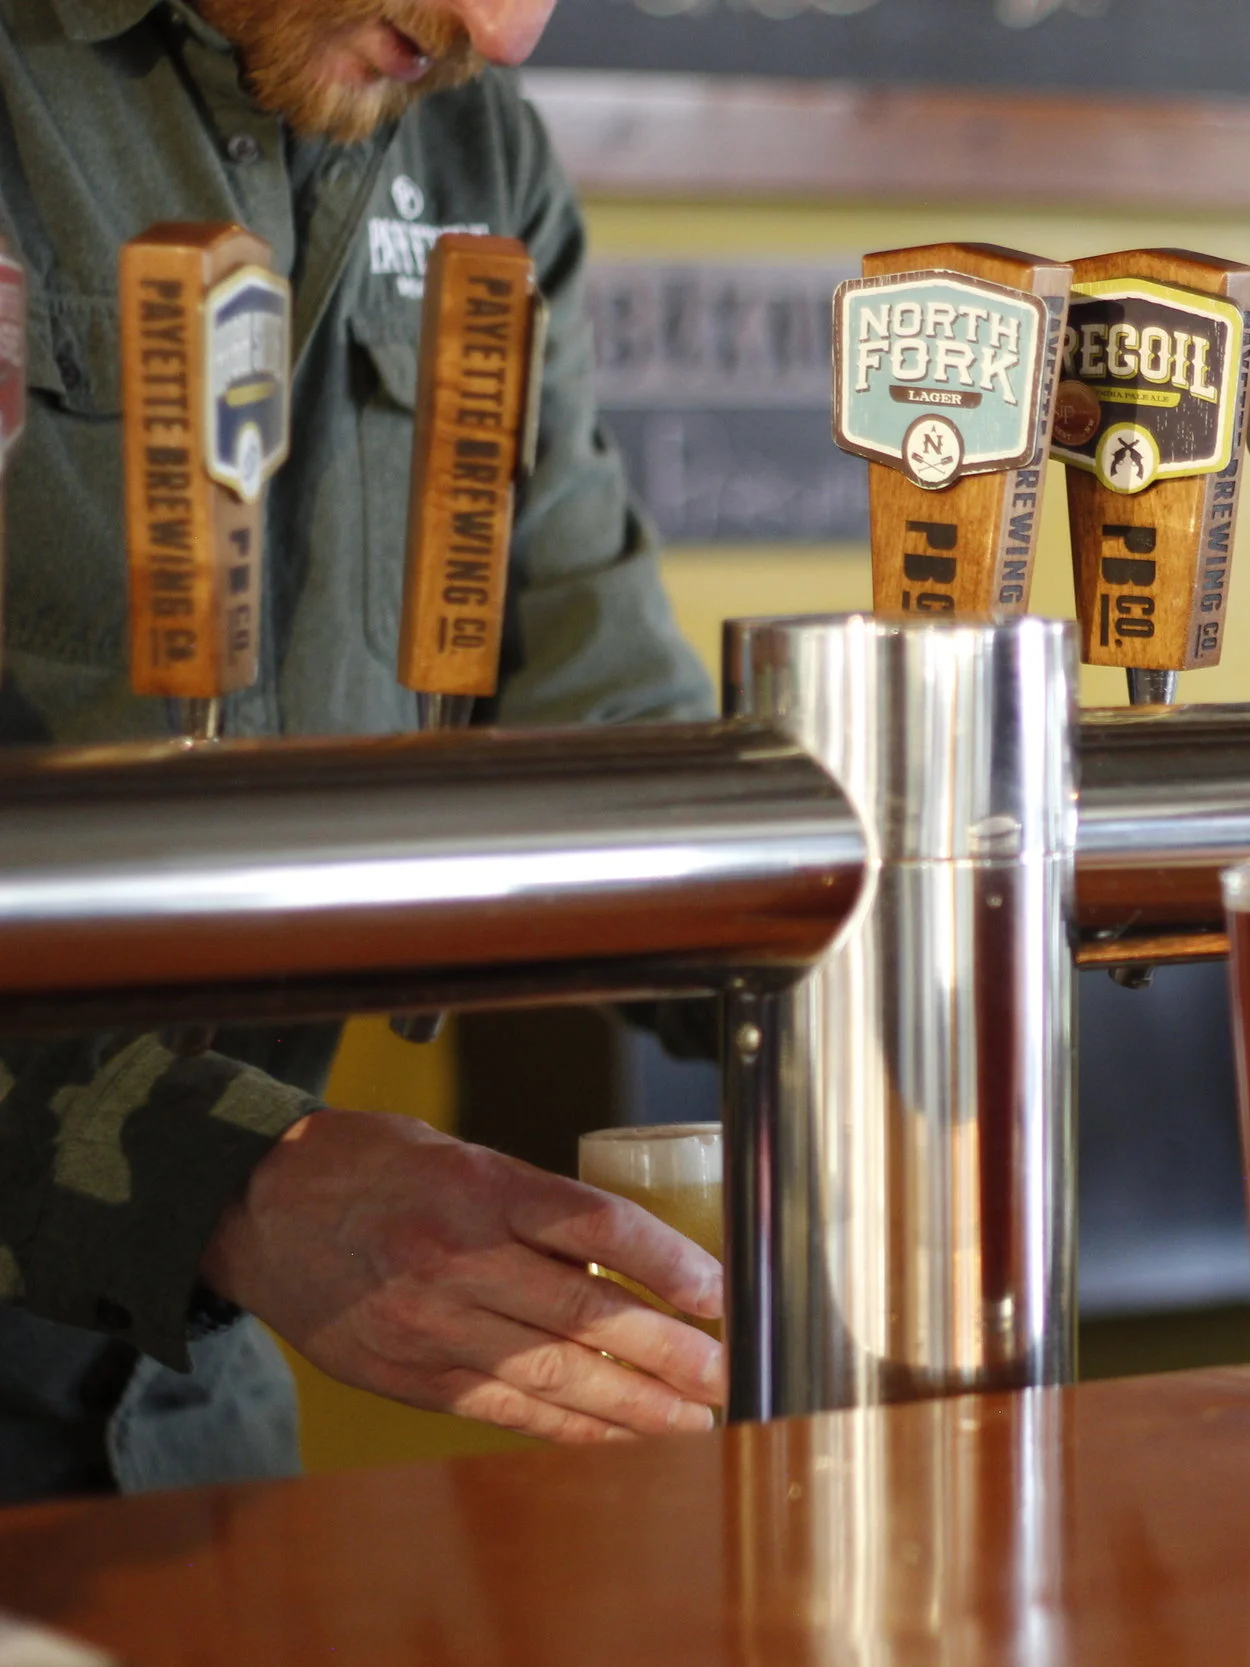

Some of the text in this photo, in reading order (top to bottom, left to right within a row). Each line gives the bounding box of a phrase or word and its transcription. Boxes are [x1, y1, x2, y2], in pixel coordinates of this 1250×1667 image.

[140, 279, 191, 431] PAYETTE
[457, 273, 513, 438] PAYETTE
[858, 301, 1021, 355] NORTH
[1062, 323, 1218, 404] RECOIL
[854, 338, 1020, 407] FORK
[908, 389, 963, 405] LAGER
[1125, 391, 1149, 400] PALE
[1151, 394, 1170, 403] ALE
[442, 437, 500, 608] BREWING
